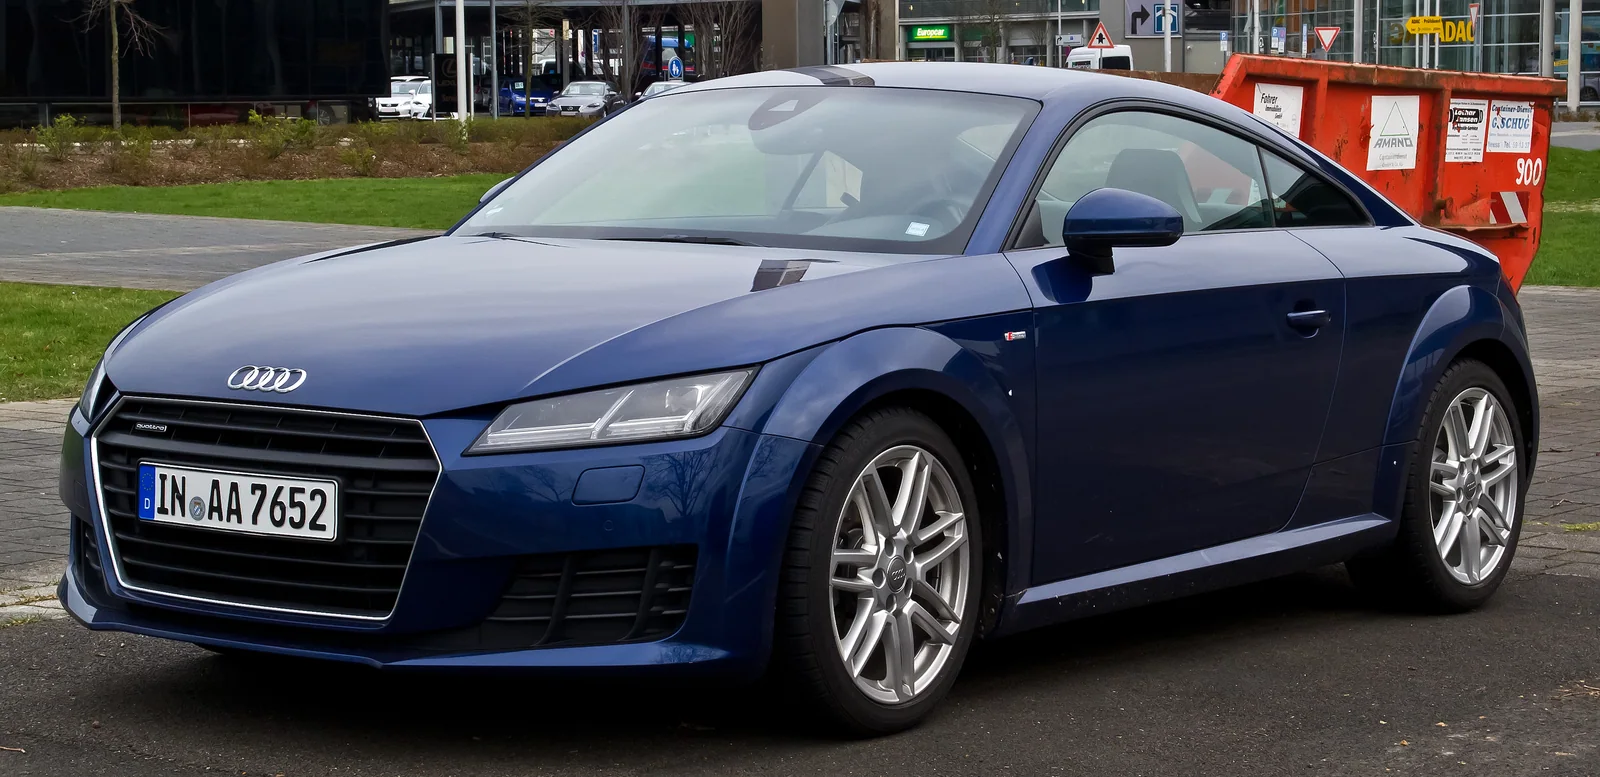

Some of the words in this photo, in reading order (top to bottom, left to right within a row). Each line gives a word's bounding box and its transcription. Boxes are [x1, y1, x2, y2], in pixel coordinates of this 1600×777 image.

[916, 27, 945, 38] Europcar
[1500, 117, 1530, 130] SCHUG
[1373, 138, 1414, 148] AMANO
[1515, 157, 1542, 186] 900
[135, 423, 167, 432] quattro
[144, 498, 150, 509] D
[157, 473, 186, 517] IN
[207, 479, 242, 524] AA
[250, 483, 327, 531] 7652
